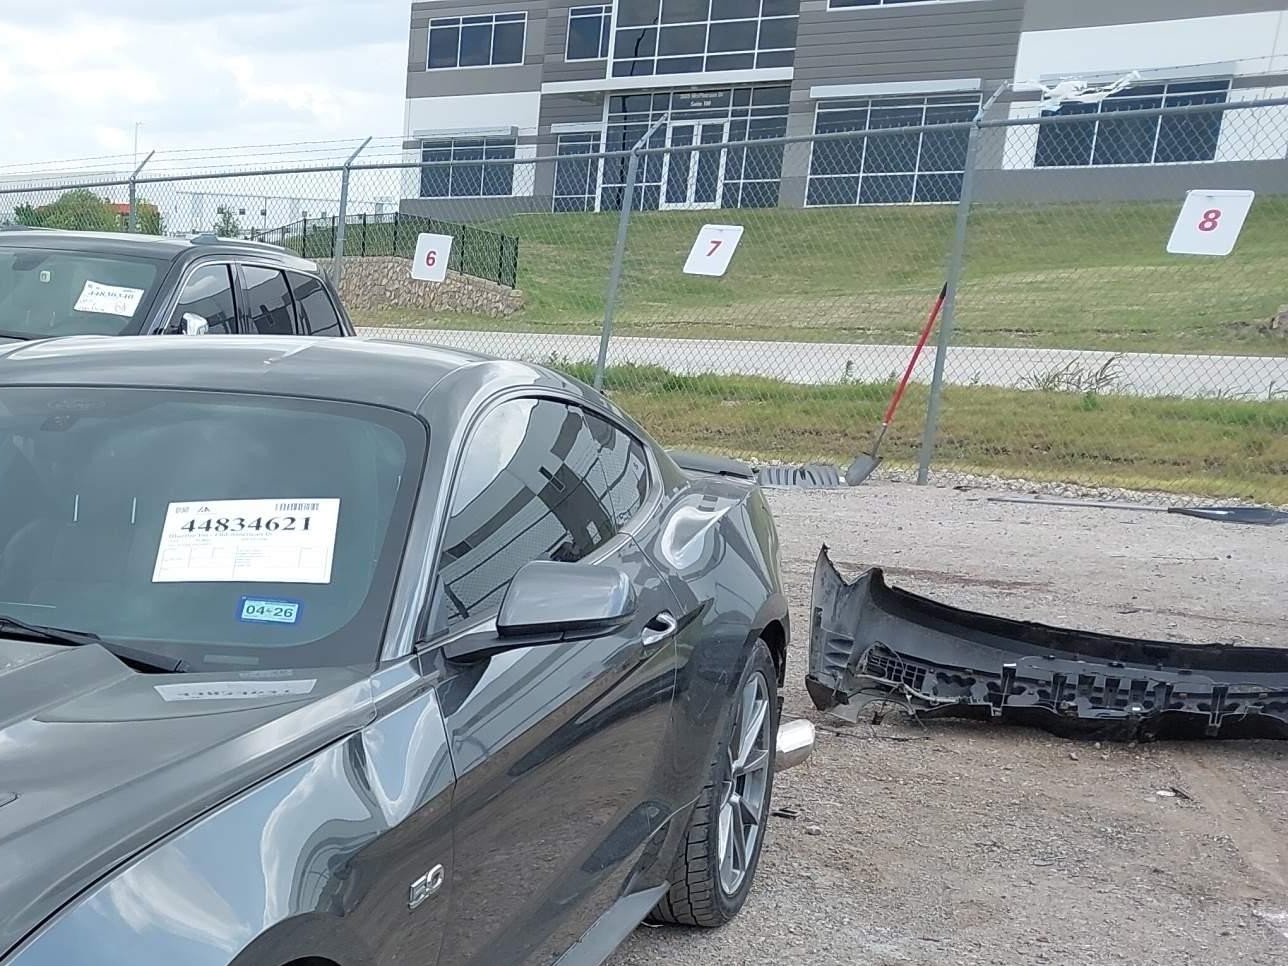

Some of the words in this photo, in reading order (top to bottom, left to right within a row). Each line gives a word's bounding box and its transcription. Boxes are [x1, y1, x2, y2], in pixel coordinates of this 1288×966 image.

[1198, 209, 1221, 231] 8
[706, 240, 722, 256] 7
[425, 250, 437, 267] 6
[180, 516, 312, 533] 44834621
